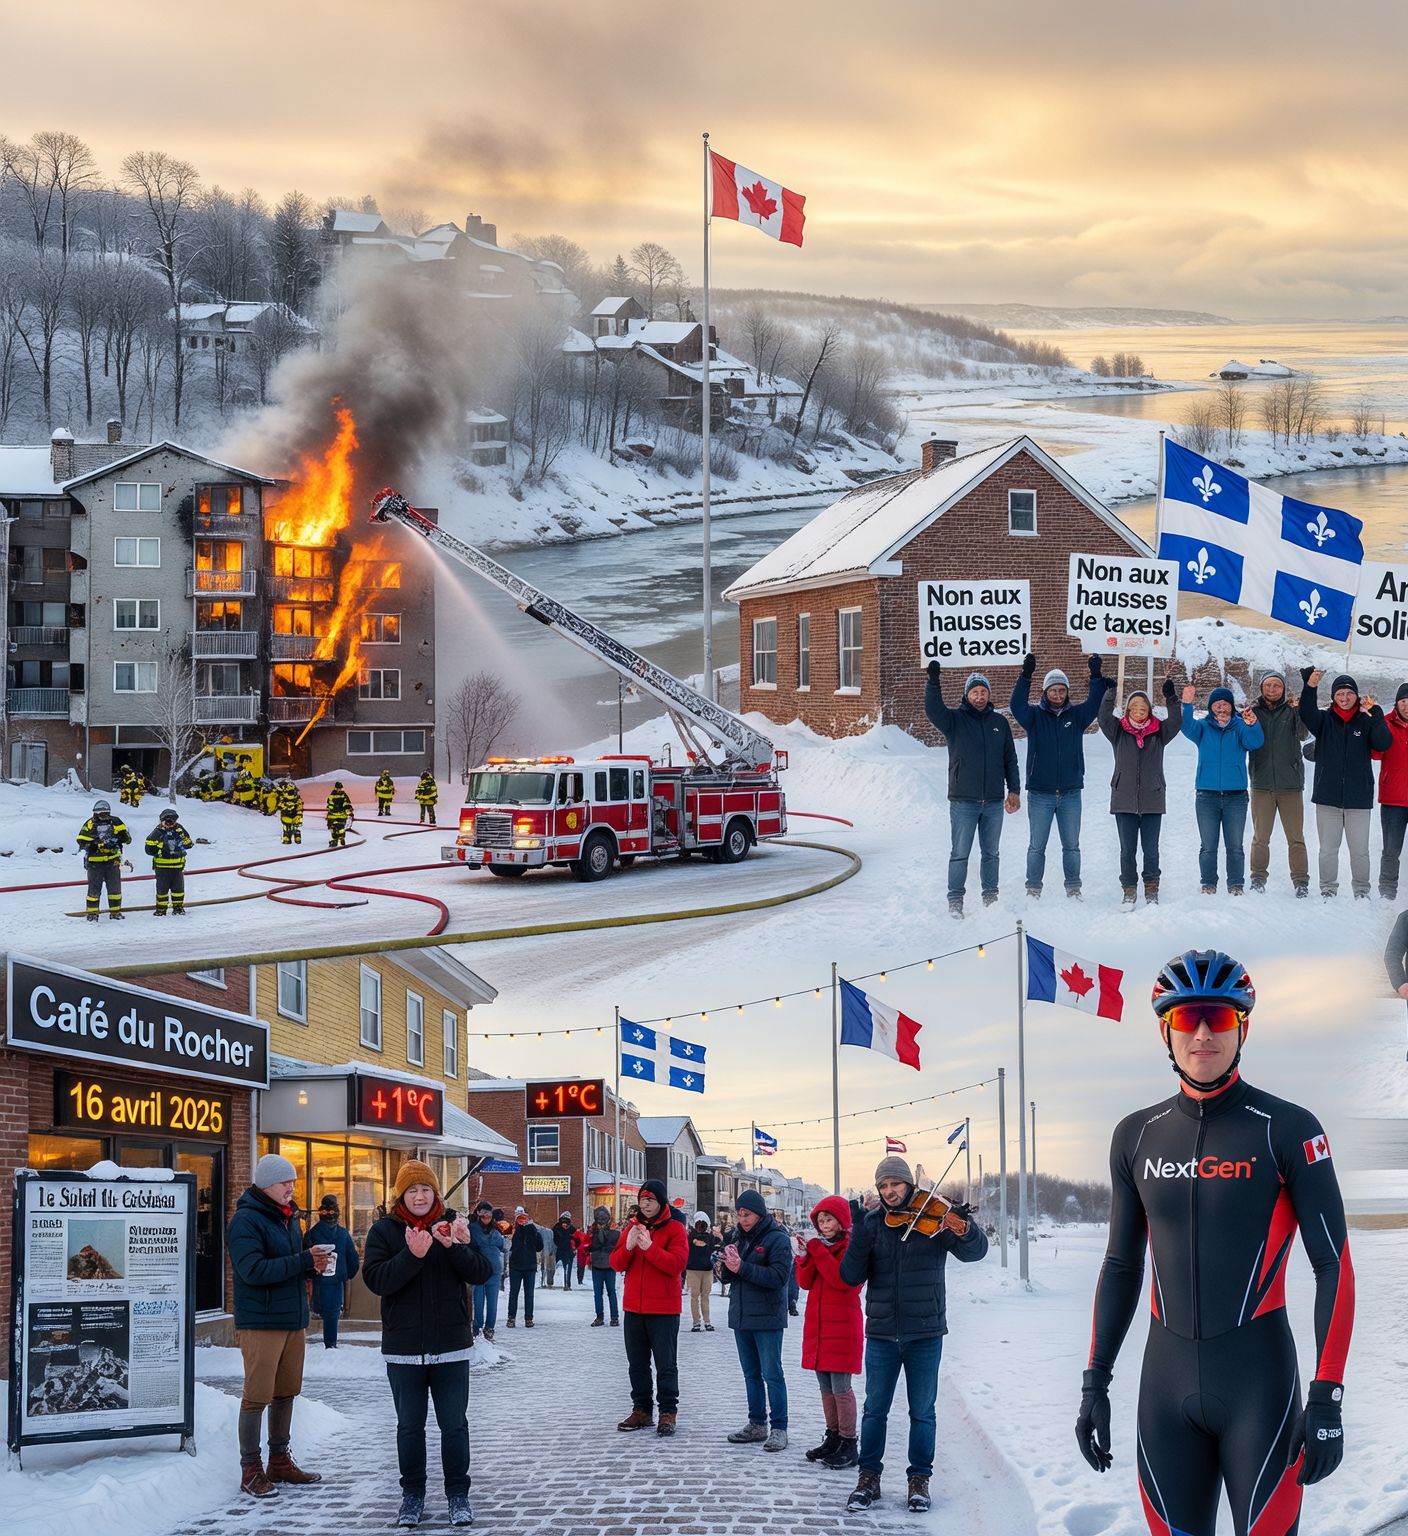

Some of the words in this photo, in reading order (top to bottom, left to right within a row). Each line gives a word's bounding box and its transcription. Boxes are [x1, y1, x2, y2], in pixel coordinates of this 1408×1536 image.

[1077, 558, 1122, 582] Non
[1129, 567, 1169, 585] aux
[927, 584, 973, 606] Non
[980, 589, 1022, 605] aux
[1076, 583, 1168, 610] hausses
[929, 610, 1022, 632] hausses
[1069, 609, 1097, 631] de
[1103, 613, 1171, 637] taxes!
[924, 635, 953, 658] de
[958, 632, 1027, 656] taxes!
[29, 985, 109, 1039] Café
[118, 1007, 155, 1049] du
[164, 1015, 254, 1068] Rocher
[70, 1081, 104, 1121] 16
[111, 1091, 162, 1126] avril
[169, 1095, 223, 1133] 2025
[371, 1086, 435, 1127] +1°C
[535, 1084, 597, 1112] +1°C
